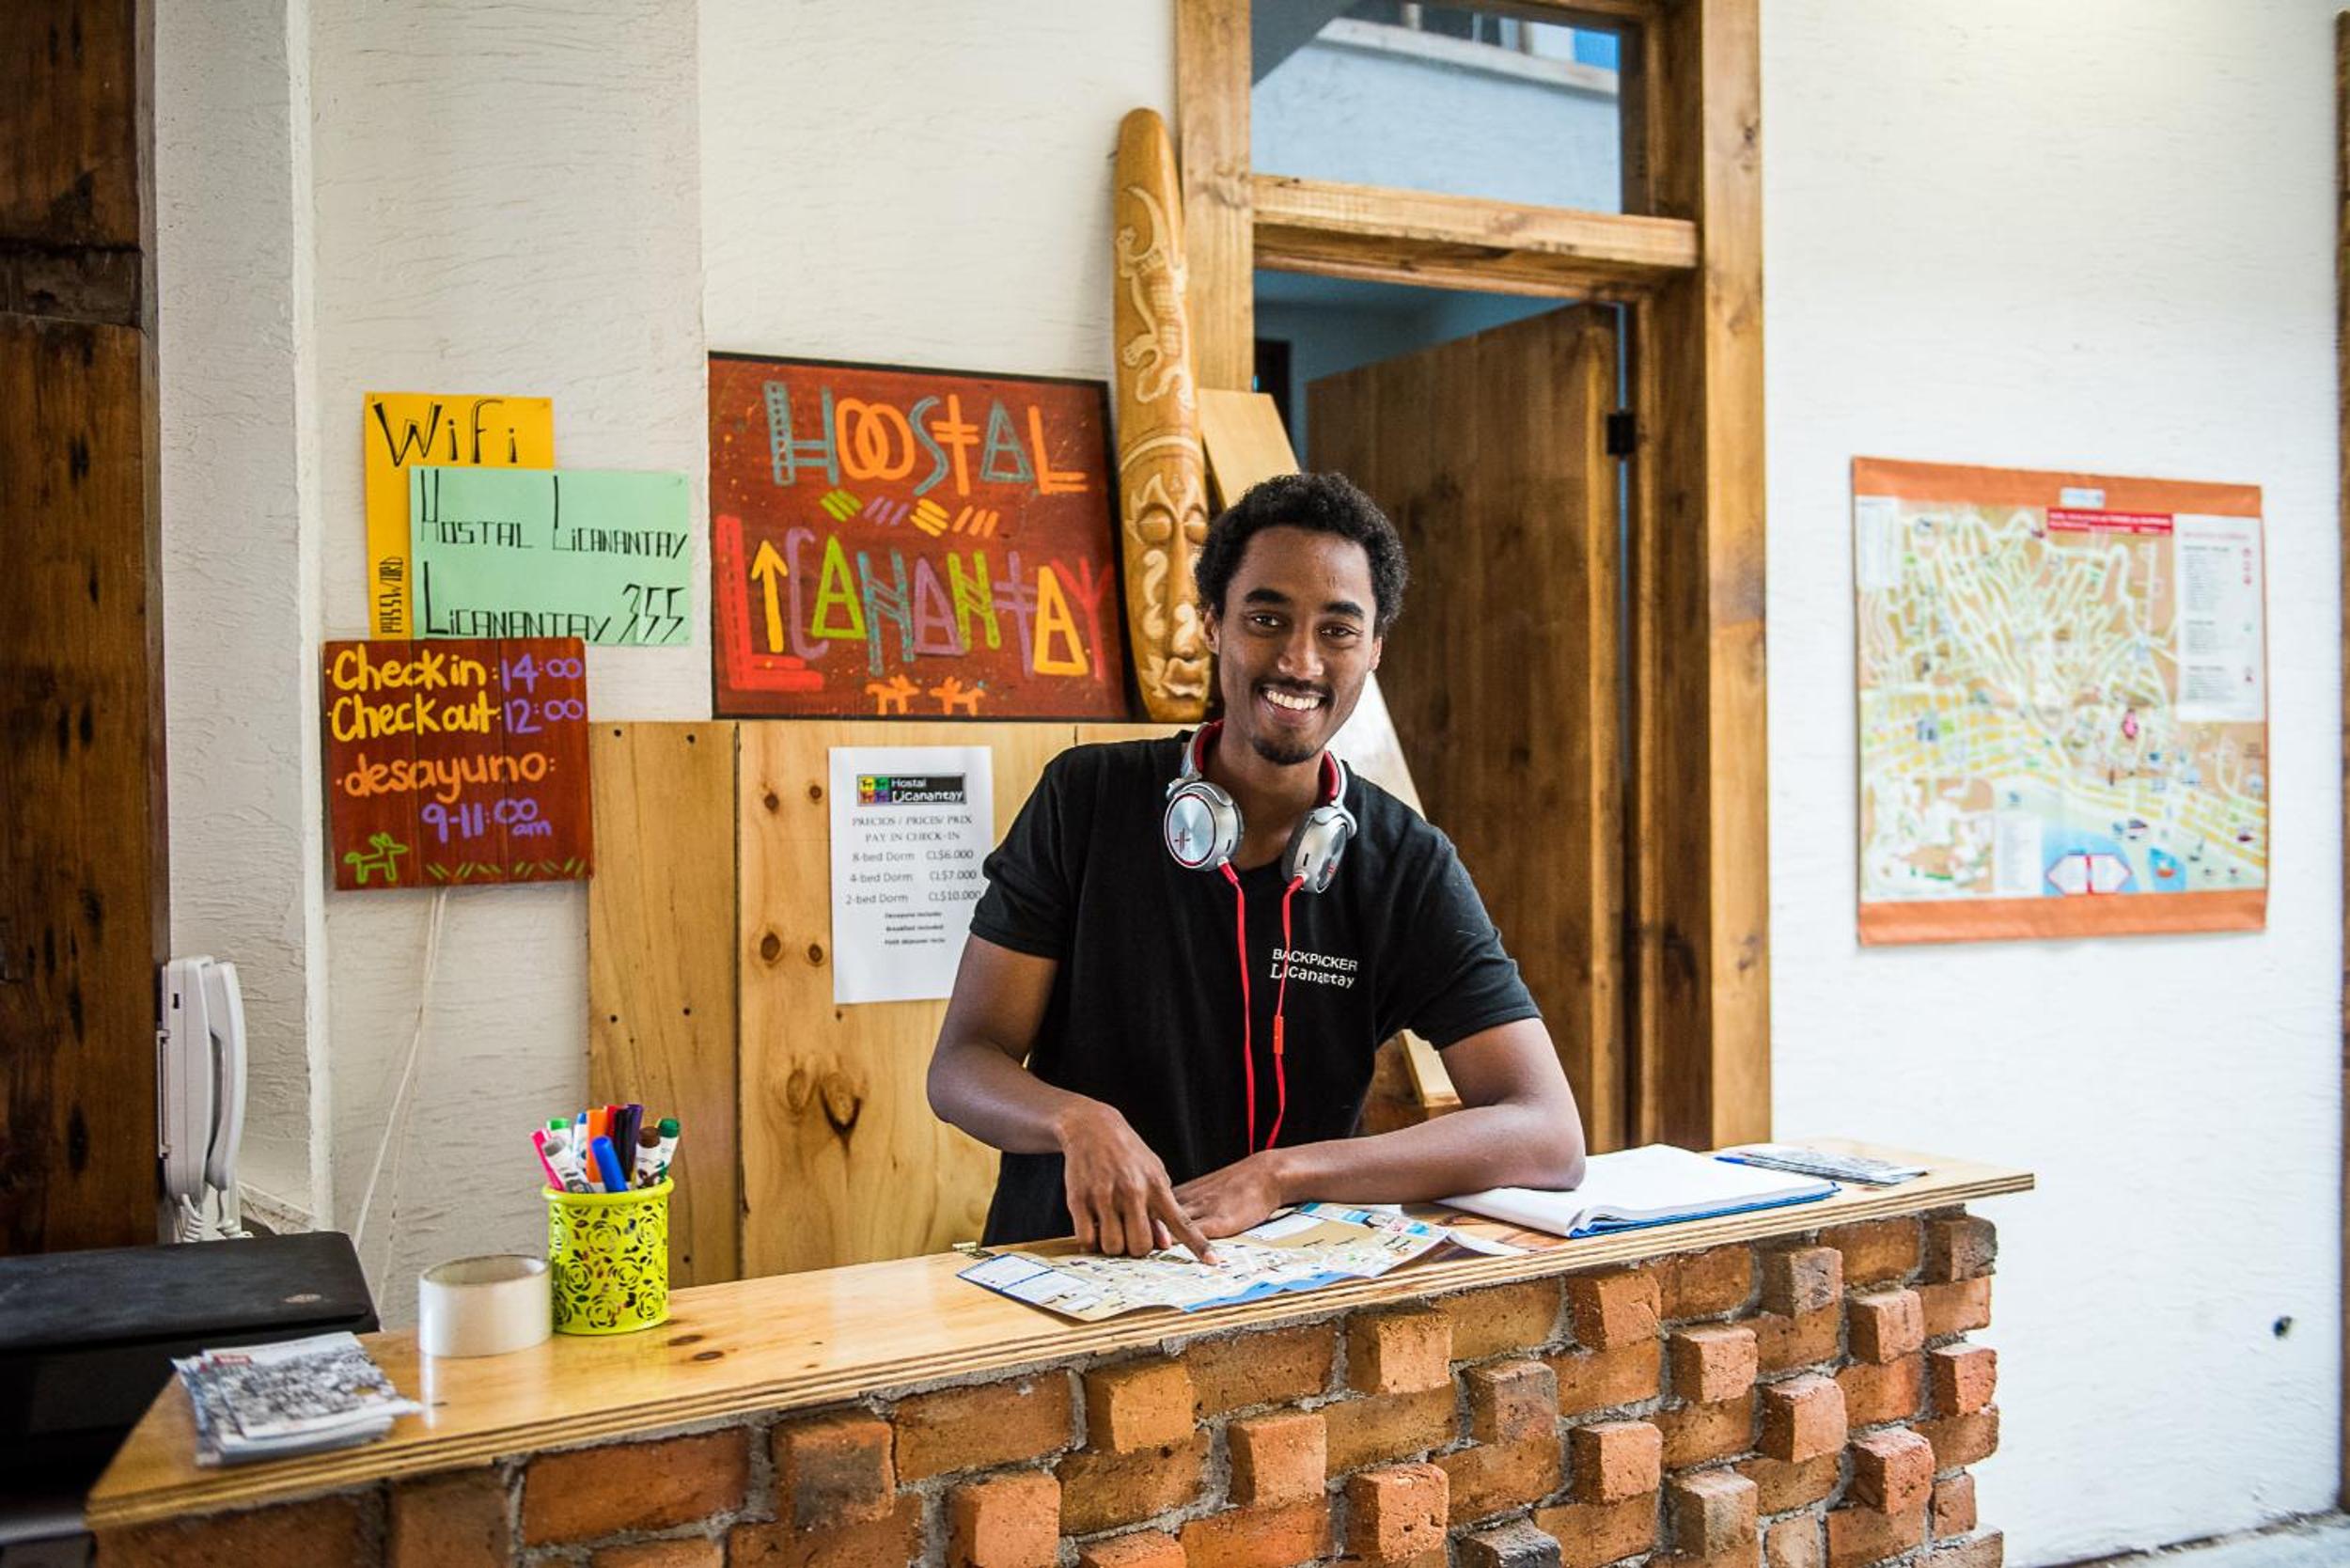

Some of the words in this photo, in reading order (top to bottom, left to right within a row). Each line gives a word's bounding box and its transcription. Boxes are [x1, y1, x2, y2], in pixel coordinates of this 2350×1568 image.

[886, 851, 916, 861] Dorm
[884, 872, 914, 883] Dorm
[879, 894, 909, 903] Dorm
